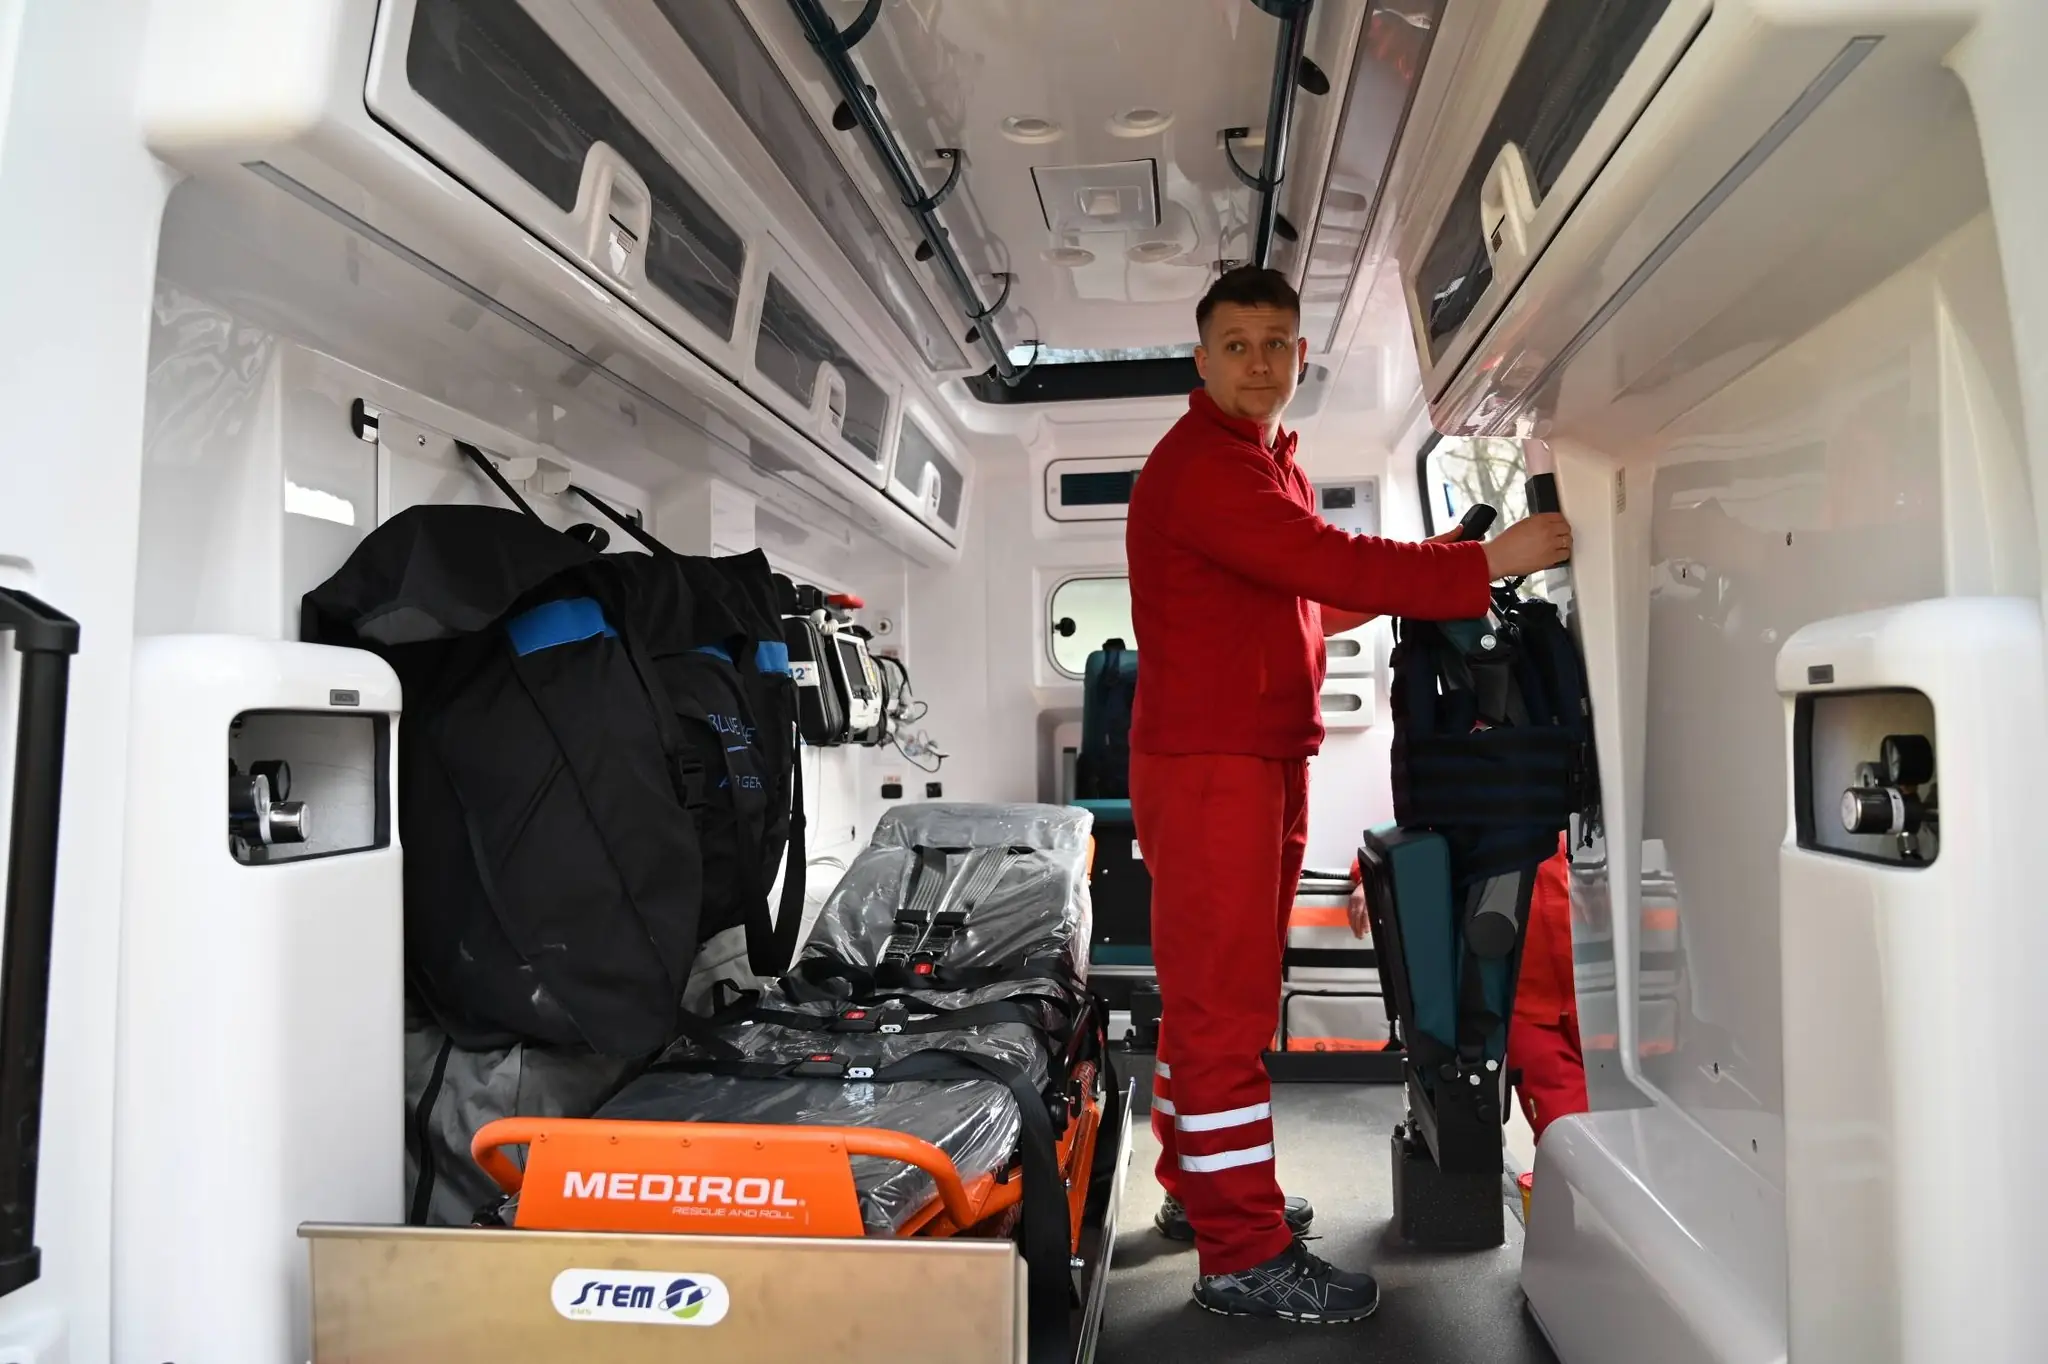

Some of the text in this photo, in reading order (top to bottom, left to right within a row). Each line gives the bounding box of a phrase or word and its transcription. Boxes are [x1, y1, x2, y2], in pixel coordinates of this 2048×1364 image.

[563, 1171, 798, 1206] MEDIROL
[672, 1205, 795, 1220] RESCUE AND ROLL
[570, 1281, 656, 1309] STEM
